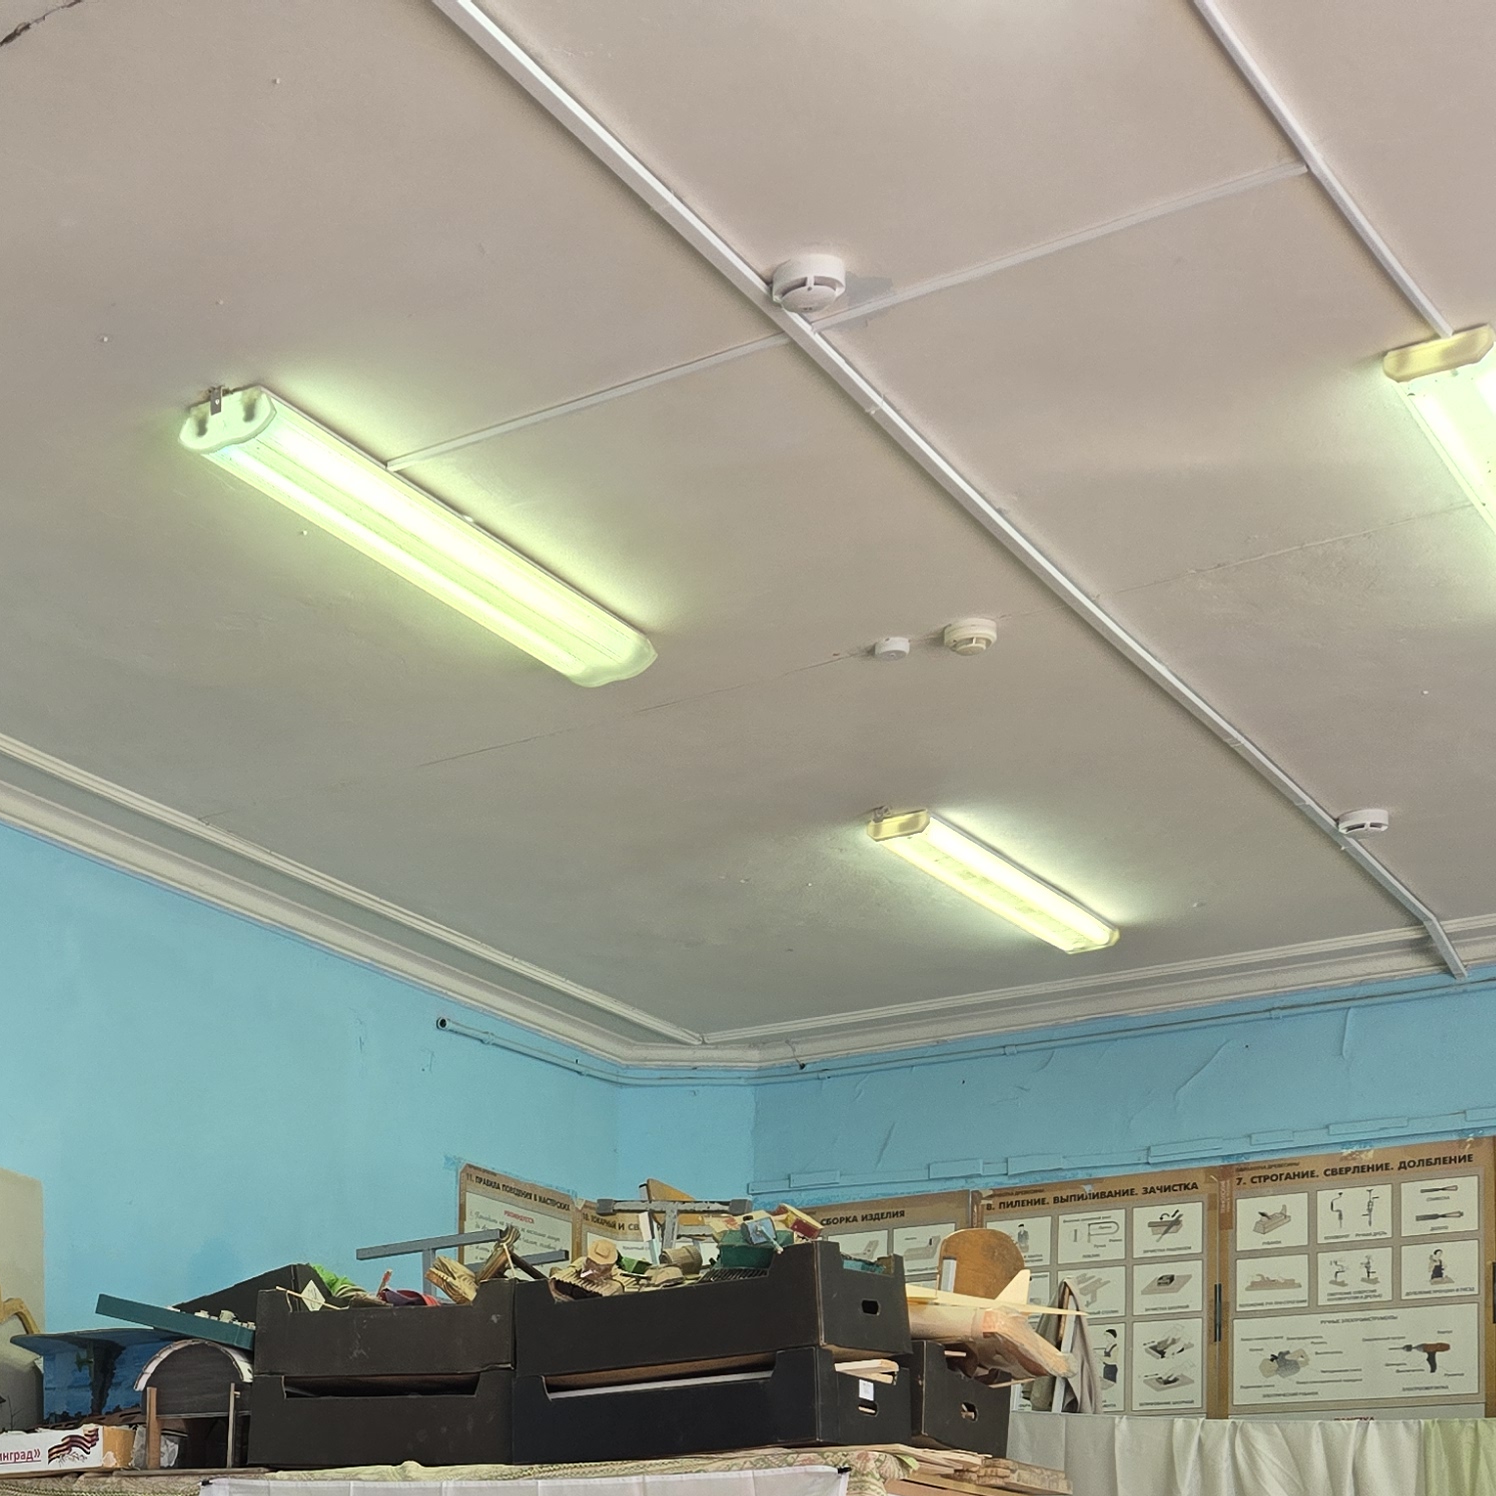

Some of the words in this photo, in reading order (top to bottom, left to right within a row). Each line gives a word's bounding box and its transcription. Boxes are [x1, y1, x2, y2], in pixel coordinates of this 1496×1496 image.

[1250, 1170, 1319, 1184] СТРОГАНИЕ.
[1324, 1162, 1393, 1177] СВЕРЛЕНИЕ.
[1398, 1154, 1473, 1171] ДОЛБЛЕНИЕ
[475, 1176, 500, 1190] ПРАВИЛА
[986, 1203, 995, 1211] 8.
[999, 1198, 1049, 1209] ПИЛЕНИЕ.
[1053, 1188, 1137, 1204] ВЫПИЛИВАНИЕ.
[1142, 1182, 1198, 1195] ЗАЧИСТКА
[820, 1215, 858, 1226] СБОРКА
[861, 1210, 905, 1221] ИЗДЕЛИЯ
